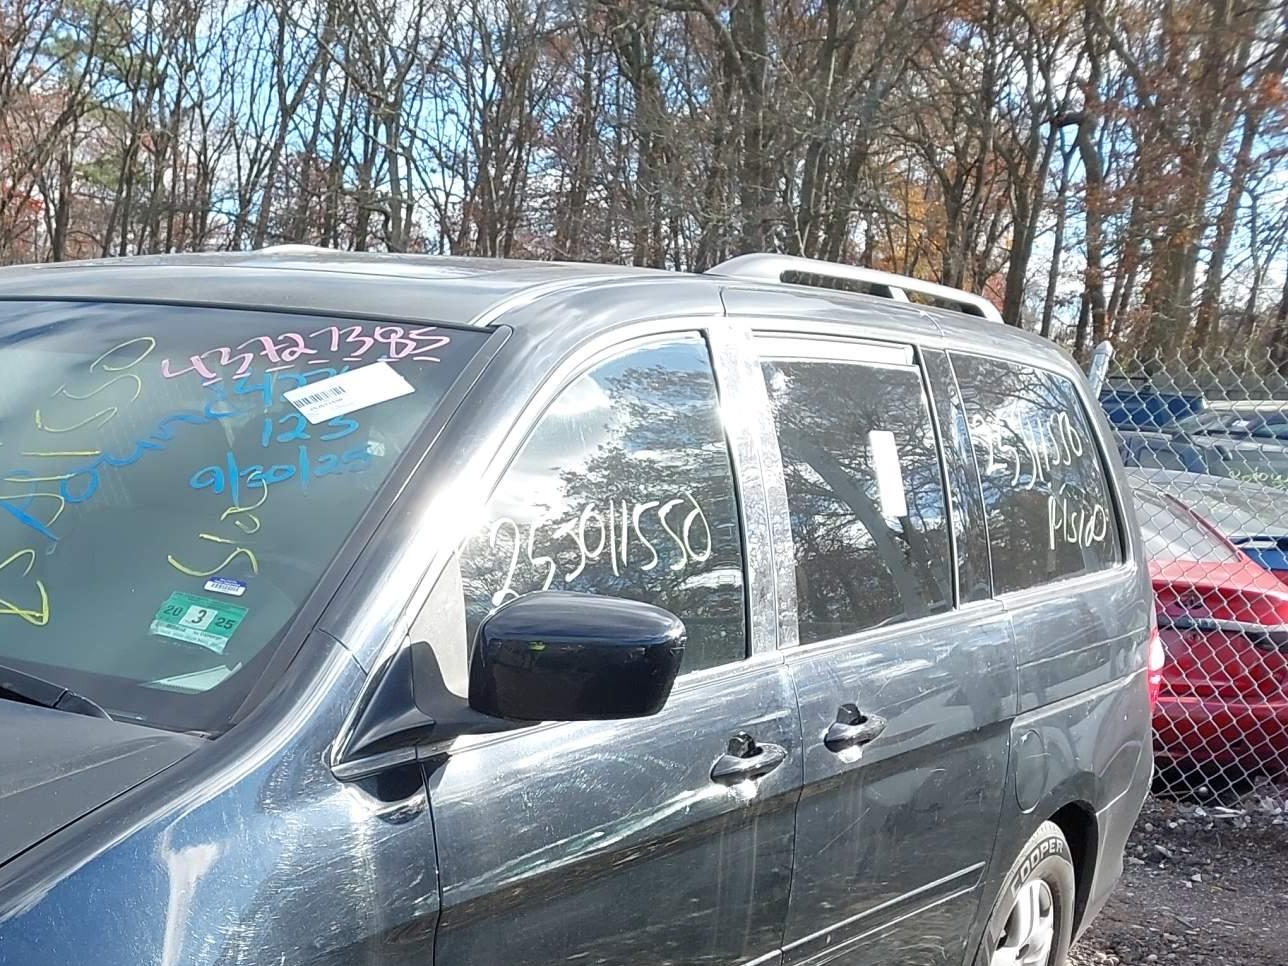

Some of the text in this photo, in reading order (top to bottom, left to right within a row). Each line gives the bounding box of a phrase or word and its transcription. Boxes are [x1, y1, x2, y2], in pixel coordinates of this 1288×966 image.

[161, 326, 452, 380] 43727385
[163, 604, 236, 630] 20 3 25
